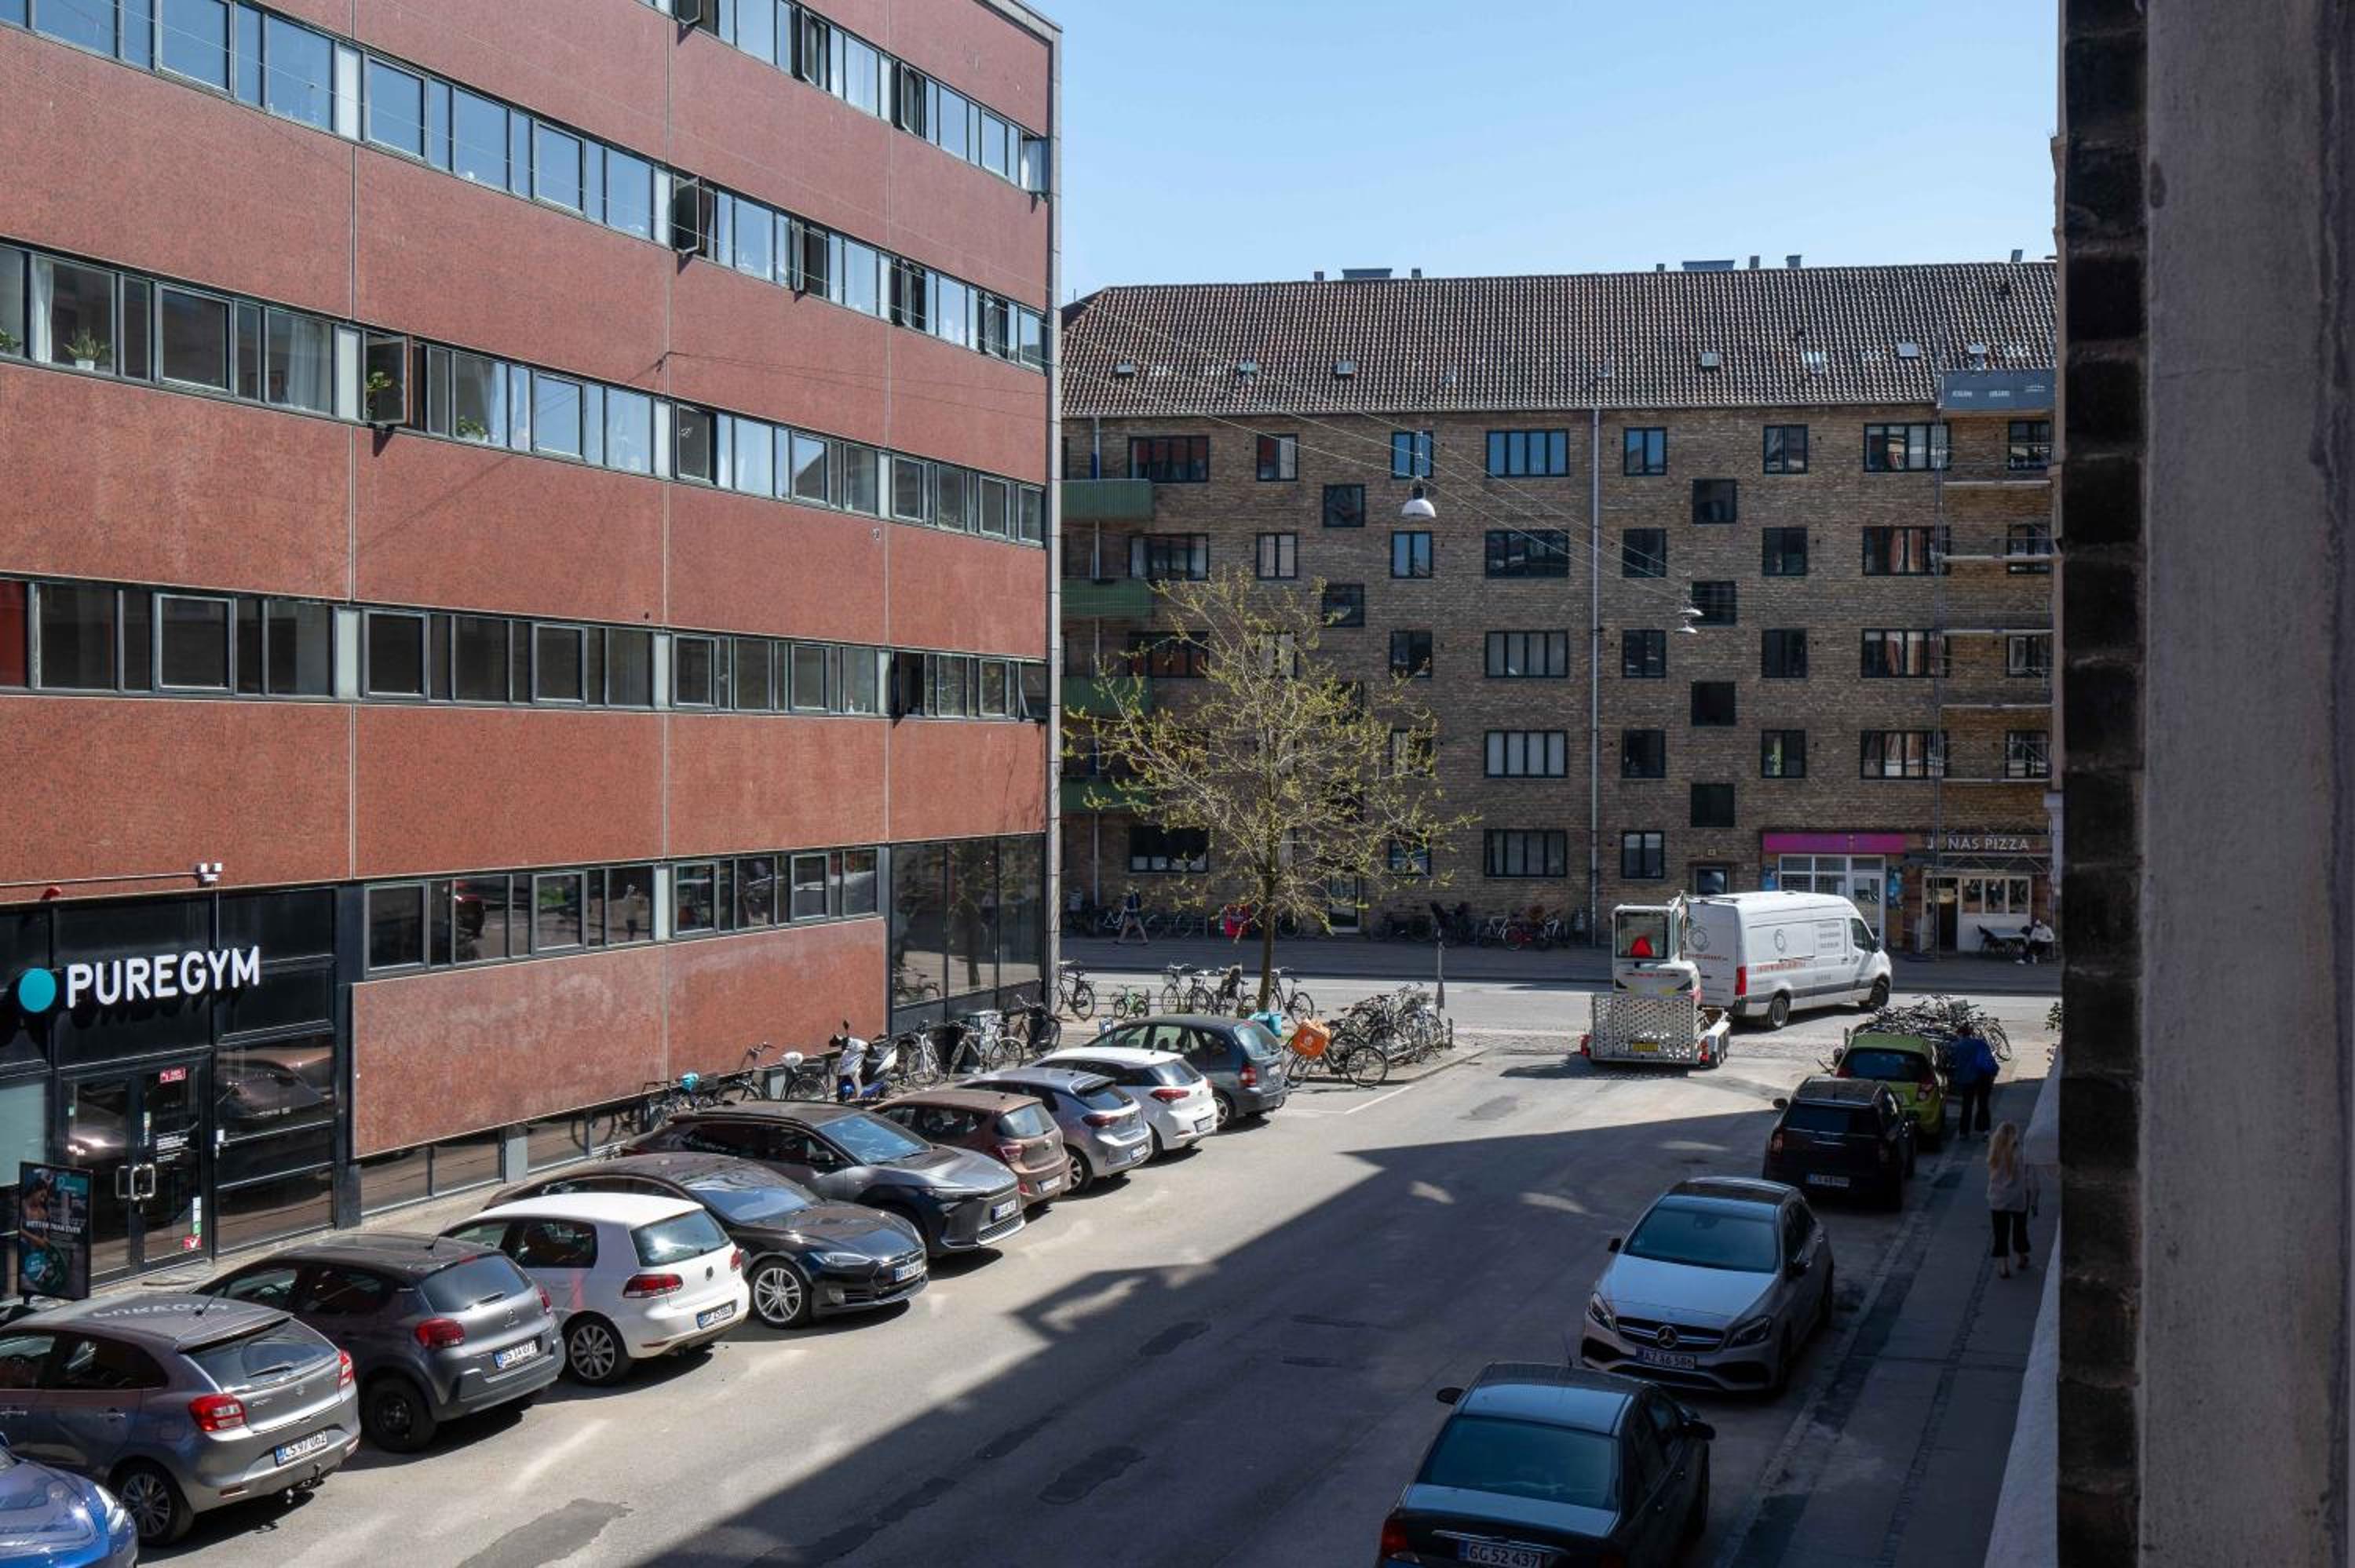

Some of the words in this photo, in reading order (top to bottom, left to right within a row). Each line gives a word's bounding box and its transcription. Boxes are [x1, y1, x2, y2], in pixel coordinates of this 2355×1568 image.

[1985, 837, 2029, 850] PIZZA
[67, 946, 261, 1008] PUREGYM
[1470, 1545, 1488, 1561] GG
[1491, 1548, 1508, 1564] 52
[1512, 1552, 1539, 1568] 437
